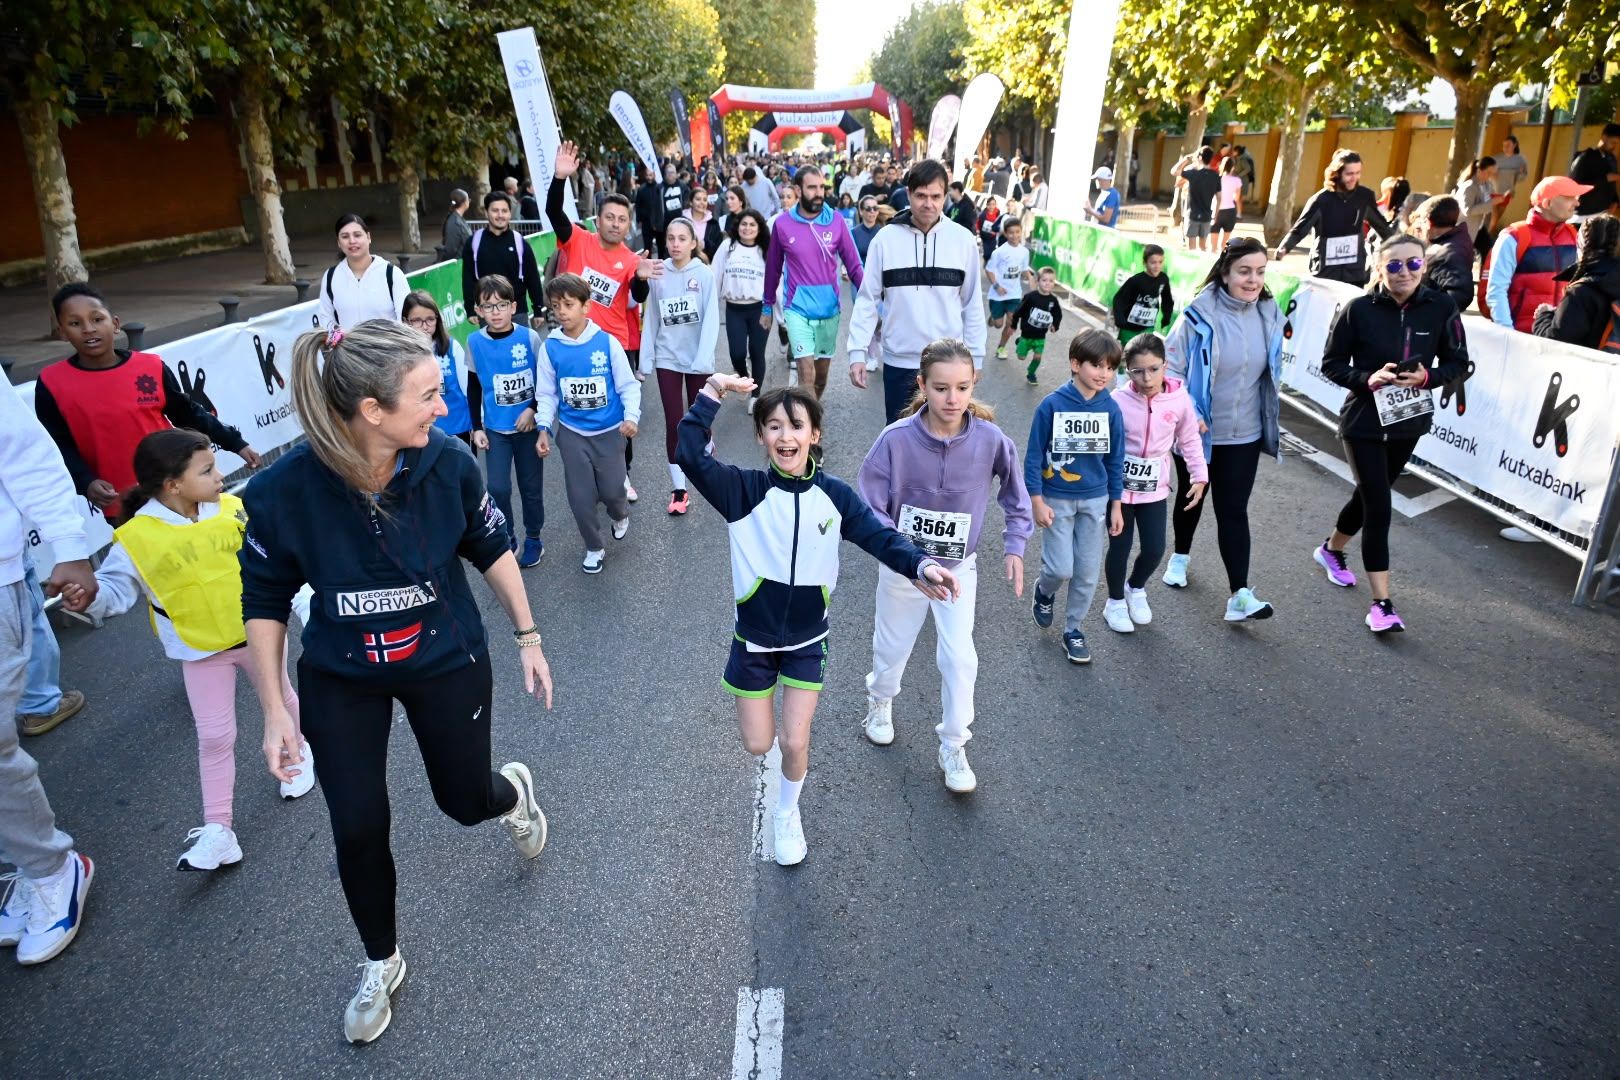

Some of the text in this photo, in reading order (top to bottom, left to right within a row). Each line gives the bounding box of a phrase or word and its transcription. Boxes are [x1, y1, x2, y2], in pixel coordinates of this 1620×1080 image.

[779, 112, 838, 124] kutxabank
[587, 274, 611, 293] 5378
[668, 301, 690, 314] 3272
[503, 377, 526, 392] 3271
[570, 383, 597, 395] 3279
[1386, 387, 1421, 407] 3526
[254, 402, 297, 429] kutxaba
[1064, 419, 1100, 434] 3600
[1123, 461, 1153, 477] 3574
[1498, 449, 1587, 503] kutxabank
[912, 515, 957, 538] 3564
[360, 585, 421, 599] GEOGRAPHIC
[341, 590, 432, 614] NORWAY
